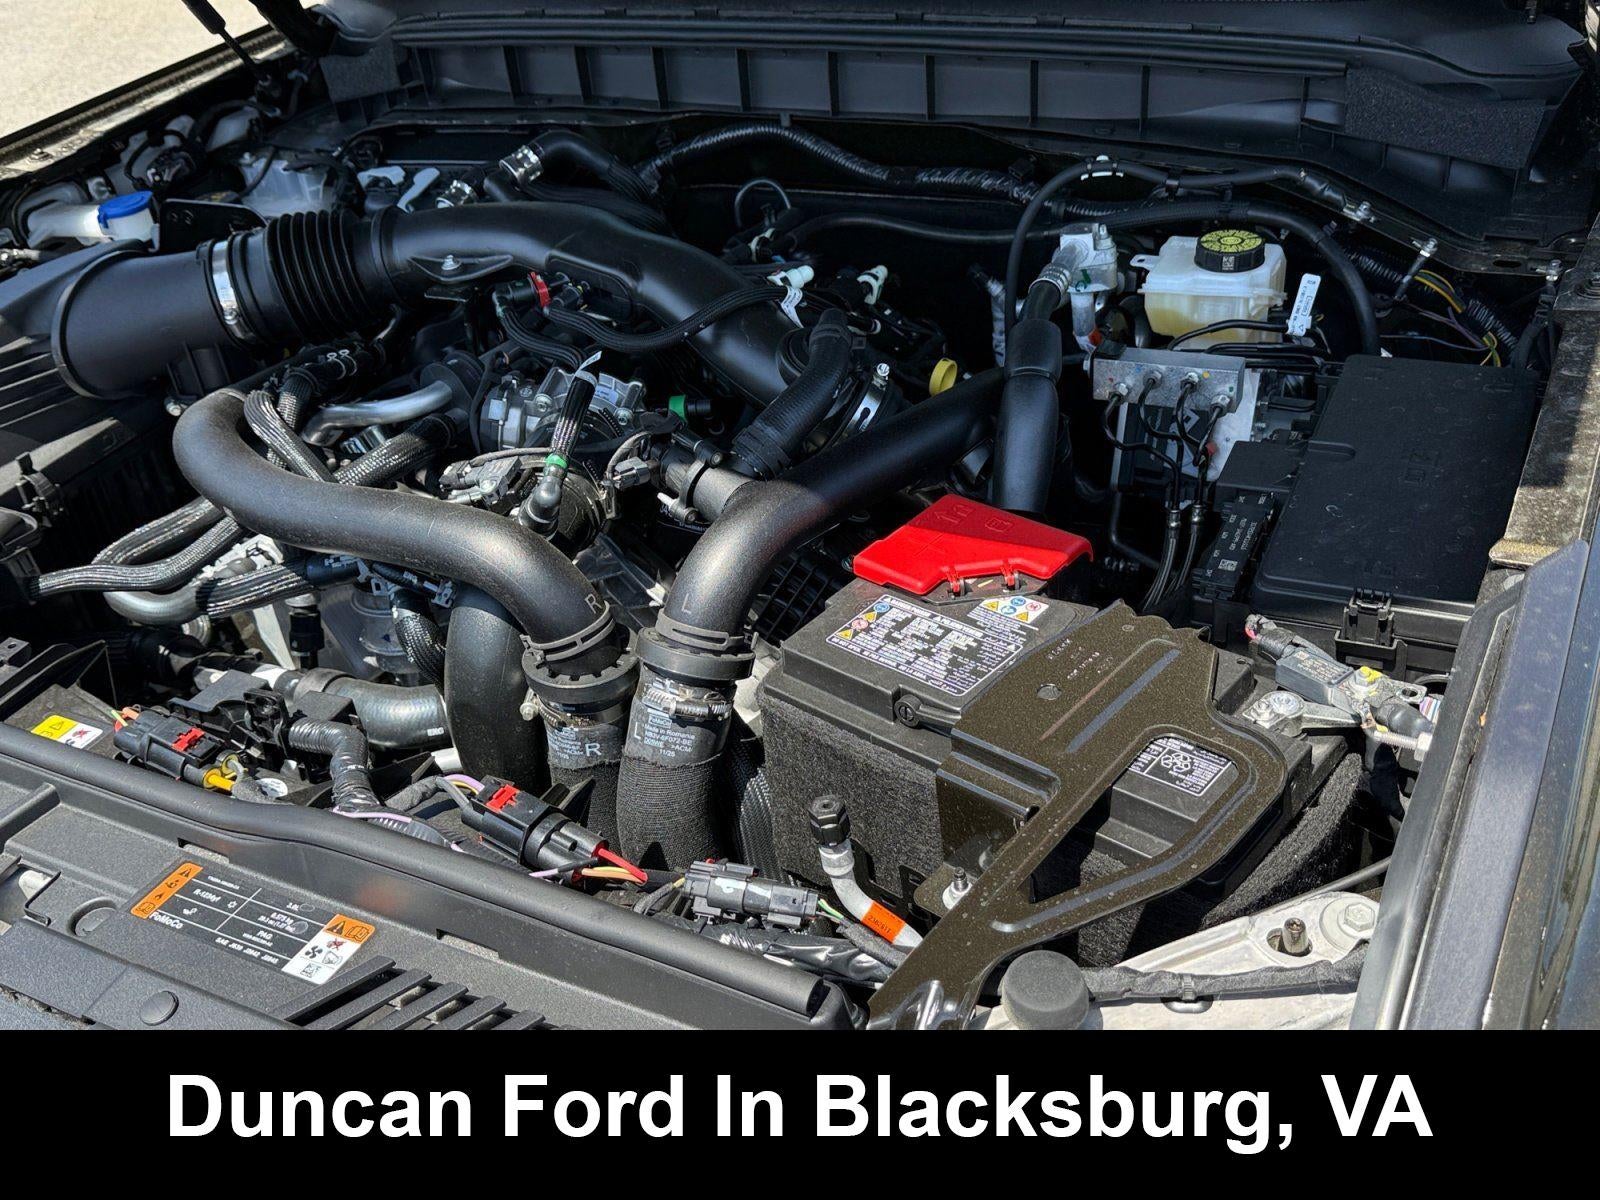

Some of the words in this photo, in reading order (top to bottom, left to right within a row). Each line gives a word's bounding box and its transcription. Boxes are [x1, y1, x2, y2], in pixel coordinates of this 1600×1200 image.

[585, 593, 602, 614] R
[635, 722, 642, 739] L
[585, 742, 602, 756] R
[149, 911, 184, 930] FoMoCo
